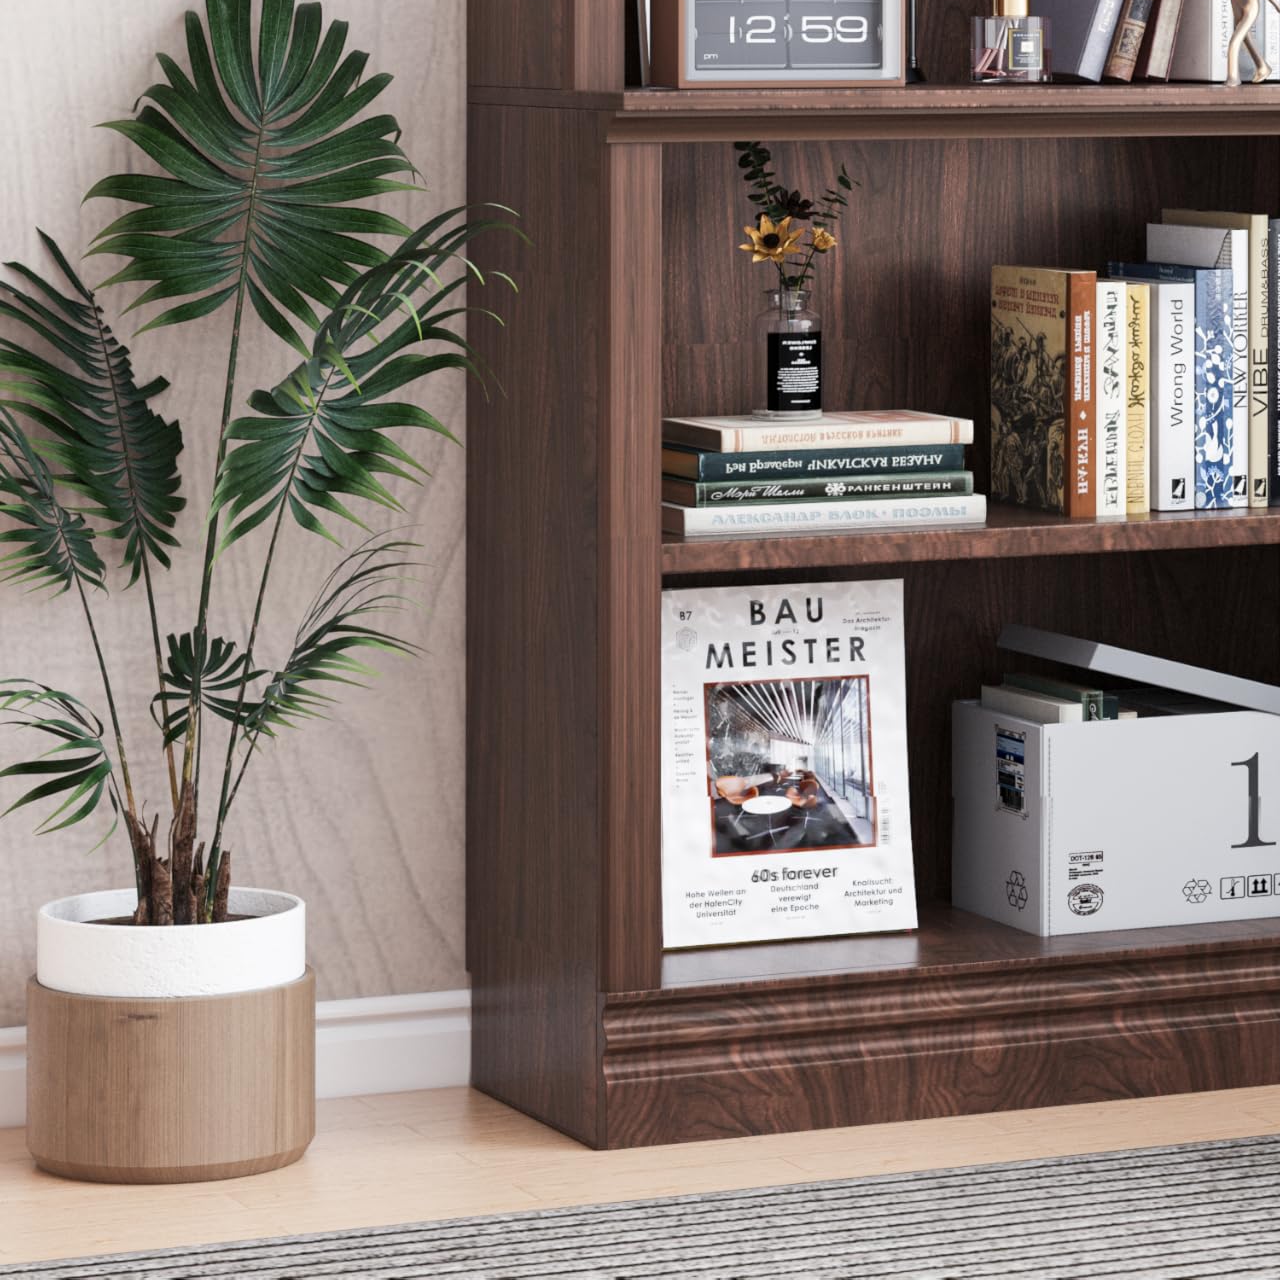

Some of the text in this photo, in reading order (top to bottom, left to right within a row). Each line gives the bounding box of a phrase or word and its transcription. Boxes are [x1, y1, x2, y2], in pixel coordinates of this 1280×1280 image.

[728, 15, 868, 44] 12 59
[703, 52, 719, 62] pm
[1170, 298, 1183, 355] World
[1252, 236, 1268, 417] VIBE DRUM&BASS
[1234, 290, 1248, 408] NEW YORKER
[1170, 358, 1187, 428] Wrong
[712, 505, 968, 526] АЛЕКСАНДР БЛОК ПОЭМЫ
[750, 597, 823, 626] BAU
[705, 636, 866, 670] MEISTER
[1230, 752, 1276, 849] 1
[751, 866, 838, 883] 60s forever
[707, 888, 734, 898] Wellen
[735, 888, 746, 896] an
[770, 882, 819, 893] Deutschland
[888, 886, 903, 896] und
[689, 900, 702, 909] der
[771, 903, 820, 914] eine Epoche
[854, 898, 894, 908] Marketing
